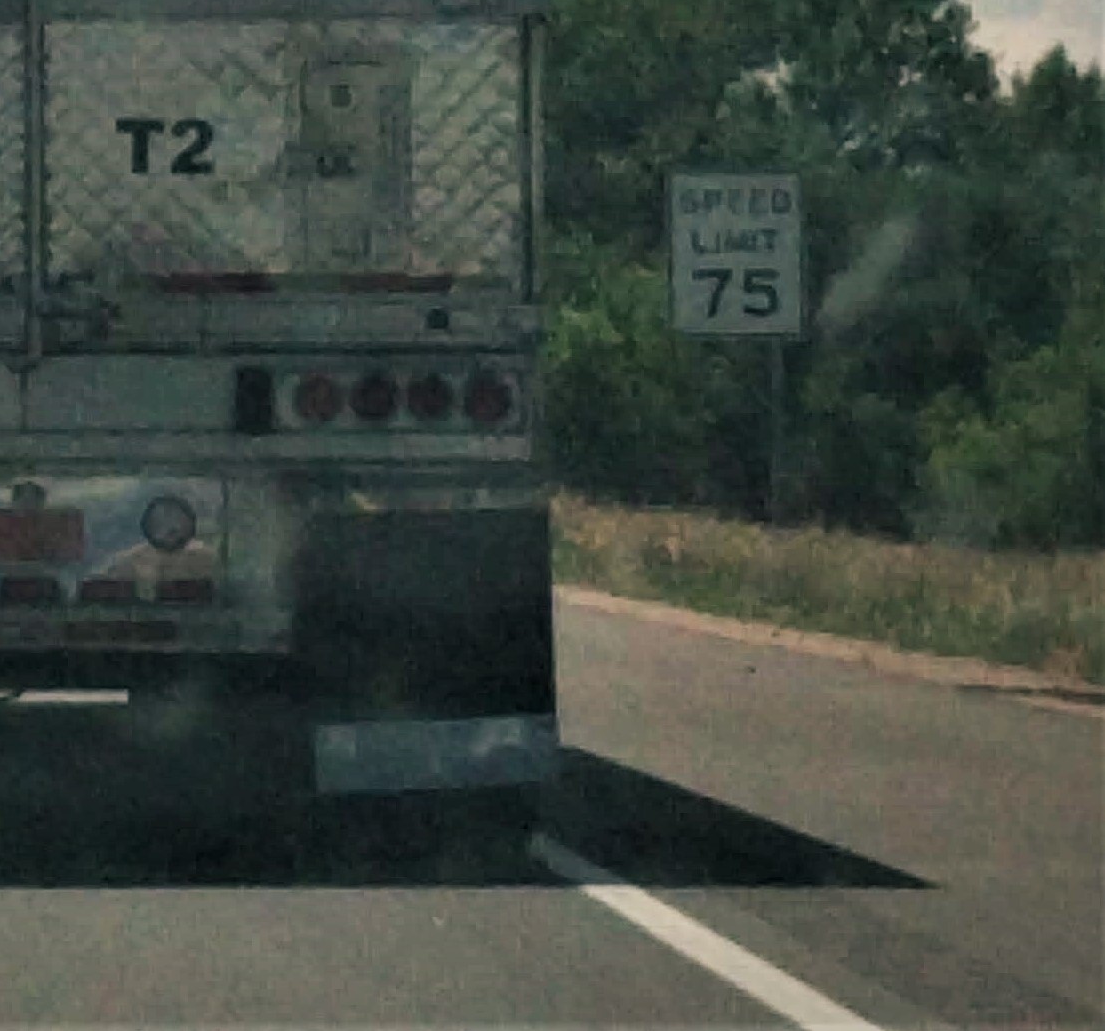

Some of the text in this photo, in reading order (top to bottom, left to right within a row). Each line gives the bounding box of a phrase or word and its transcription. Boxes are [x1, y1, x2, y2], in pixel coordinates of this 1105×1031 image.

[115, 117, 215, 174] T2
[679, 187, 793, 215] SPEED
[690, 228, 777, 255] LIMIT
[692, 268, 781, 318] 75
